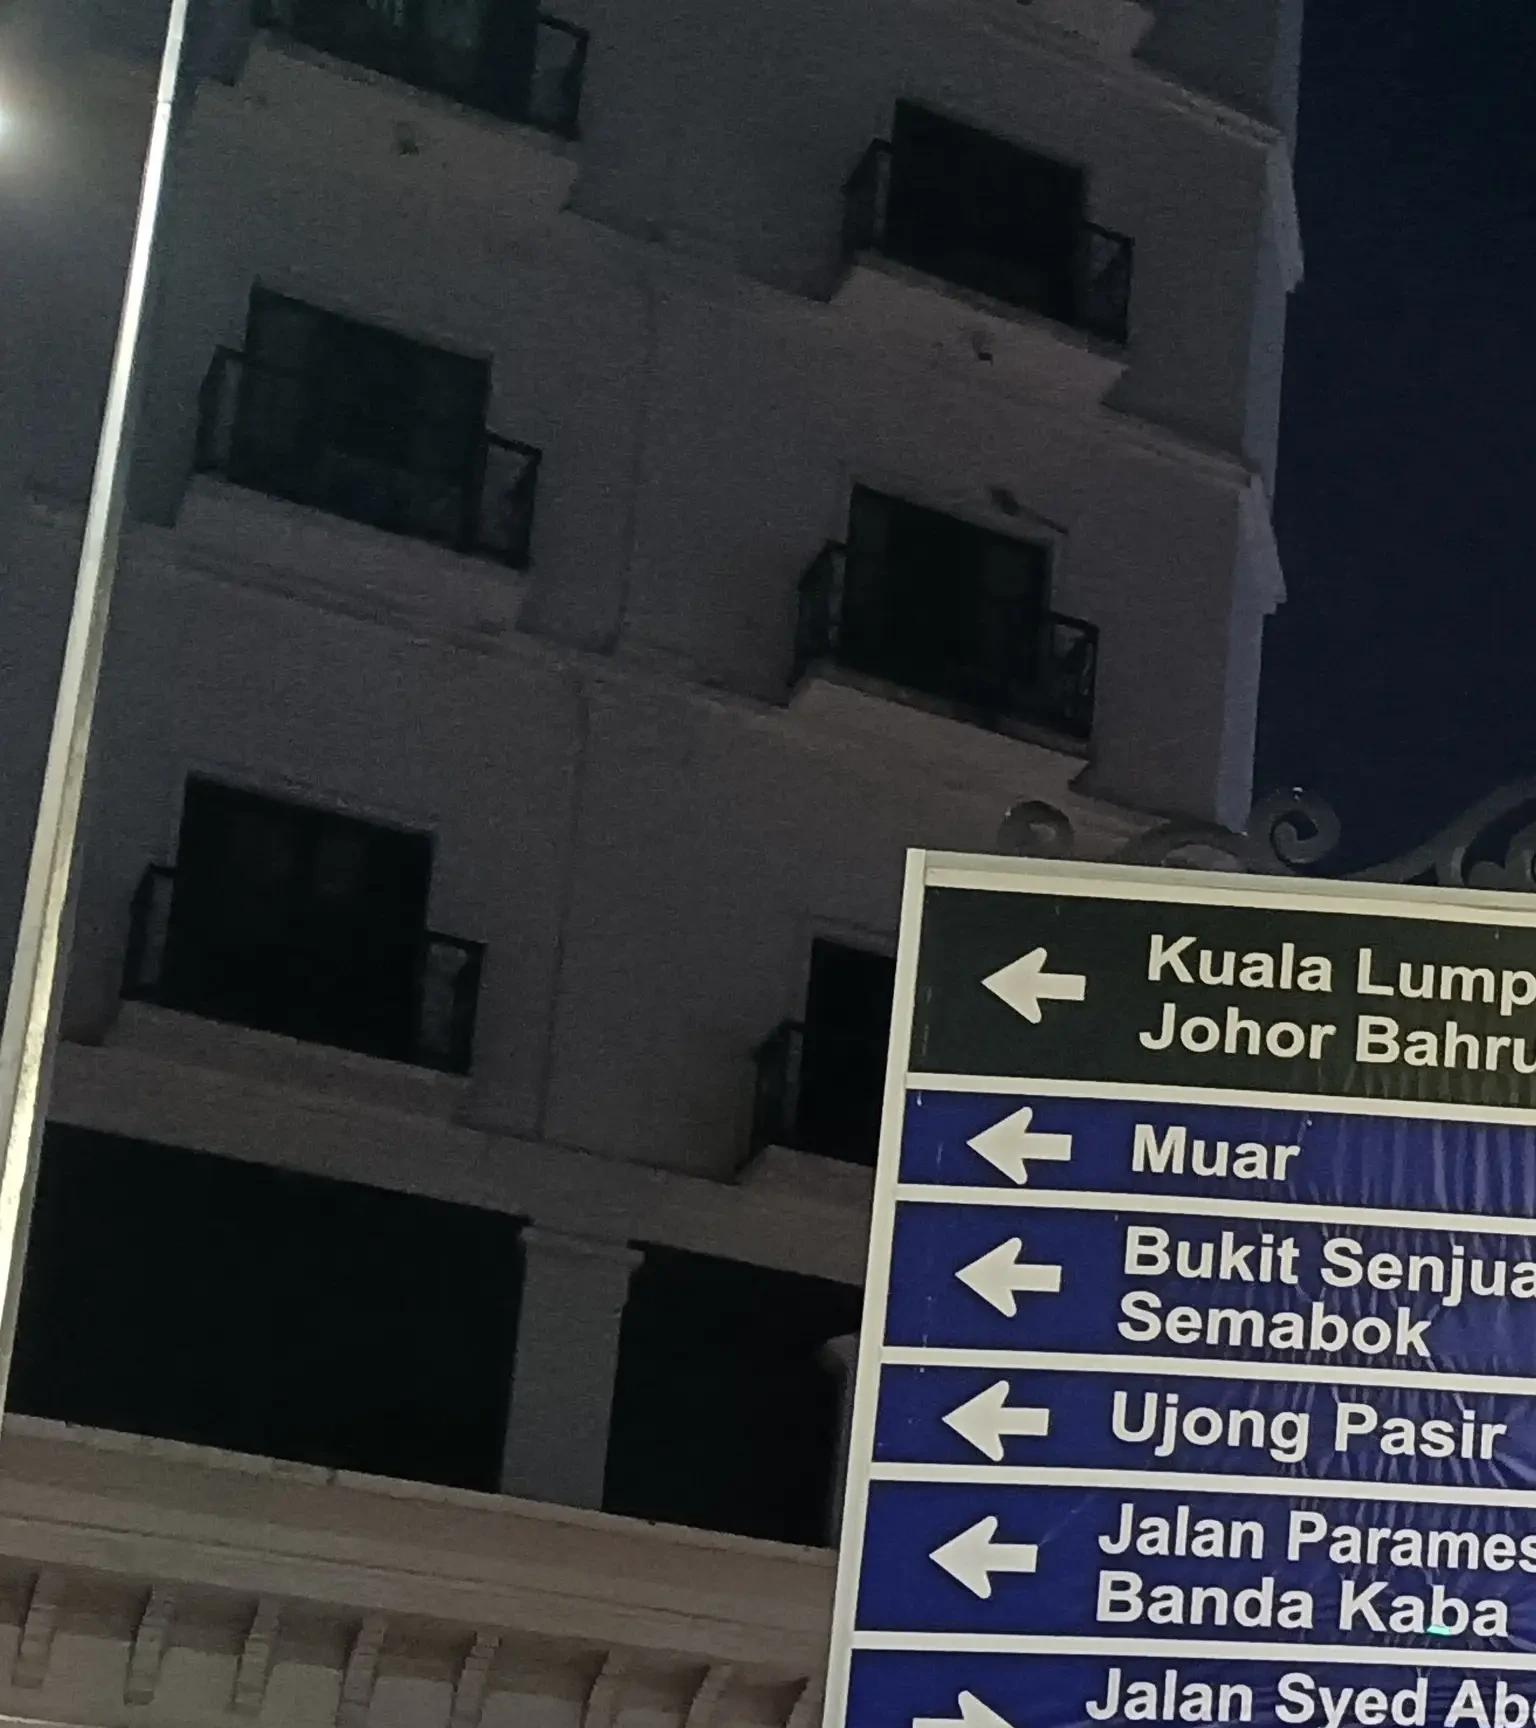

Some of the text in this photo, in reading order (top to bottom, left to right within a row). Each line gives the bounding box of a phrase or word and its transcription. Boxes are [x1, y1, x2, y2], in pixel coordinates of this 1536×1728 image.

[1148, 934, 1332, 993] Kuala
[1139, 1003, 1335, 1060] Johor
[1131, 1124, 1300, 1181] Muar
[1123, 1226, 1300, 1284] Bukit
[1117, 1291, 1432, 1357] Semabok
[1111, 1391, 1507, 1463] Ujong Pasir
[1098, 1503, 1264, 1559] Jalan
[1096, 1570, 1508, 1638] Banda Kaba
[1086, 1668, 1253, 1722] Jalan
